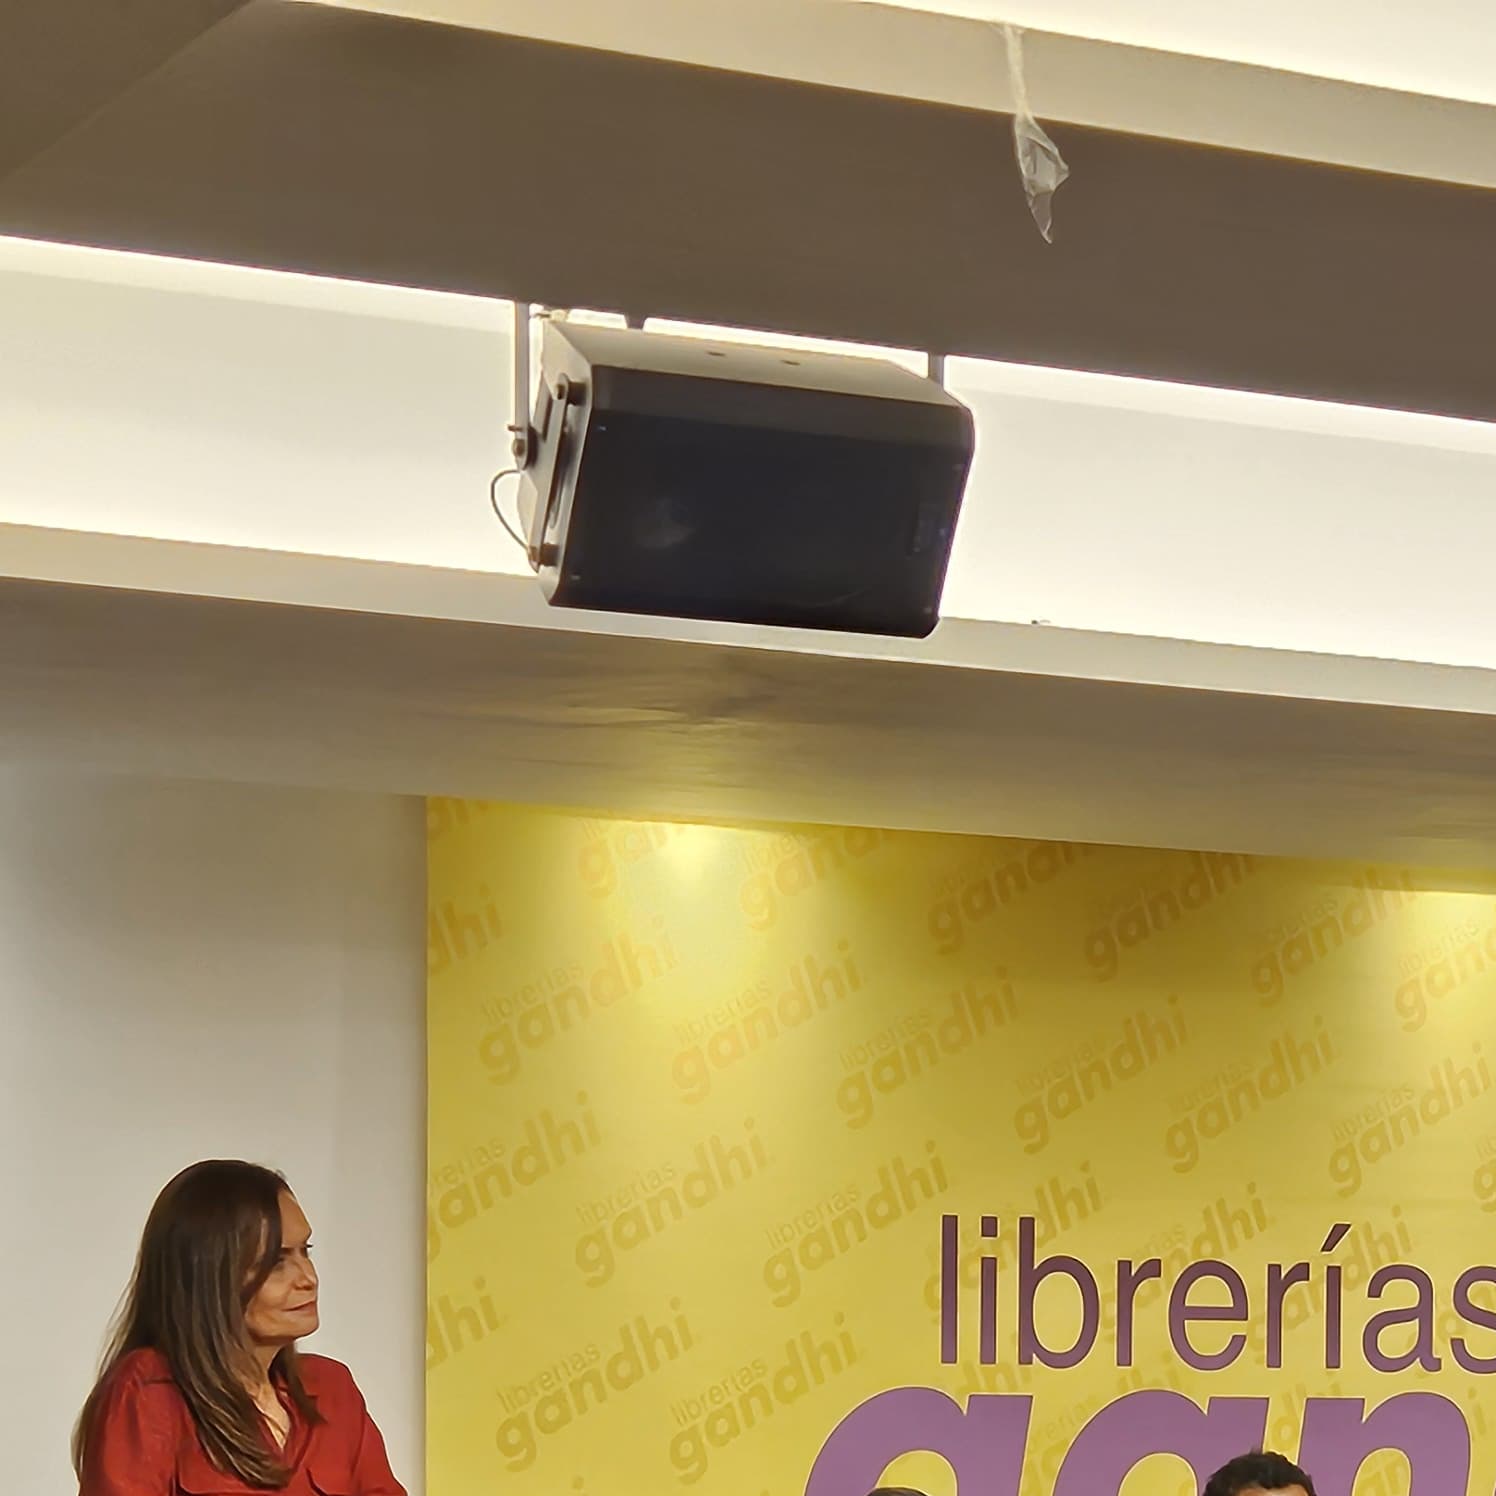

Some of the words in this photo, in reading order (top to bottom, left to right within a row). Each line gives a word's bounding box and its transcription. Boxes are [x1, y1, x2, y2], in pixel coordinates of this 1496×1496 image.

[477, 914, 679, 1086] gandhi
[672, 938, 862, 1104] gandhi
[836, 964, 1019, 1130] gandhi
[1013, 993, 1188, 1155] gandhi
[1165, 1014, 1334, 1174] gandhi
[1329, 1039, 1491, 1199] gandhi
[574, 1115, 767, 1288] gandhi
[763, 1139, 948, 1308] gandhi
[495, 1296, 694, 1472] gandhi
[668, 1311, 857, 1485] gandhi
